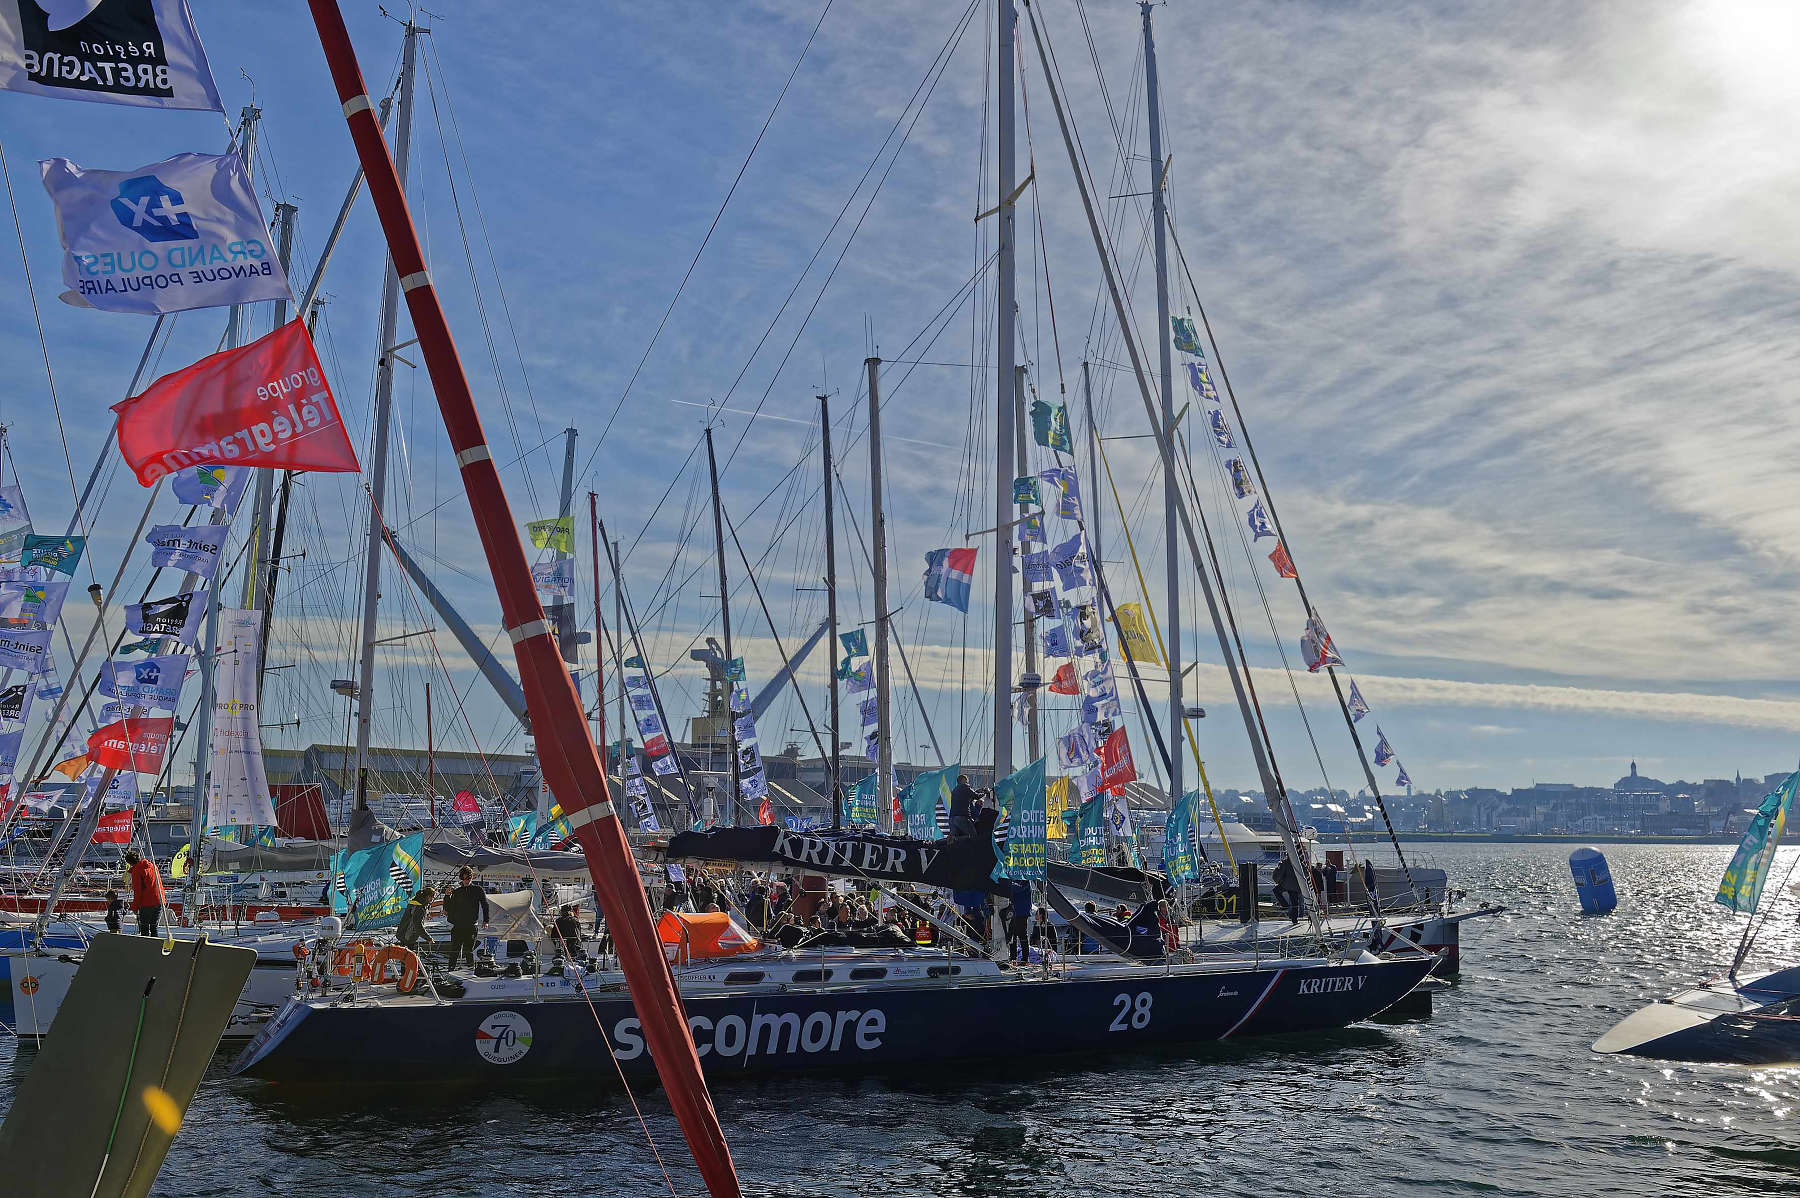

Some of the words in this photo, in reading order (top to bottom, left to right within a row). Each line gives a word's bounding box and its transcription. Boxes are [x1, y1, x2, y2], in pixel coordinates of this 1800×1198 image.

[239, 703, 255, 711] PRO
[772, 827, 908, 874] KRITER
[916, 849, 941, 875] V
[1297, 977, 1353, 995] KRITER
[1357, 975, 1368, 991] V
[1108, 991, 1154, 1032] 28
[491, 1024, 517, 1054] 70
[613, 1003, 887, 1064] scomore
